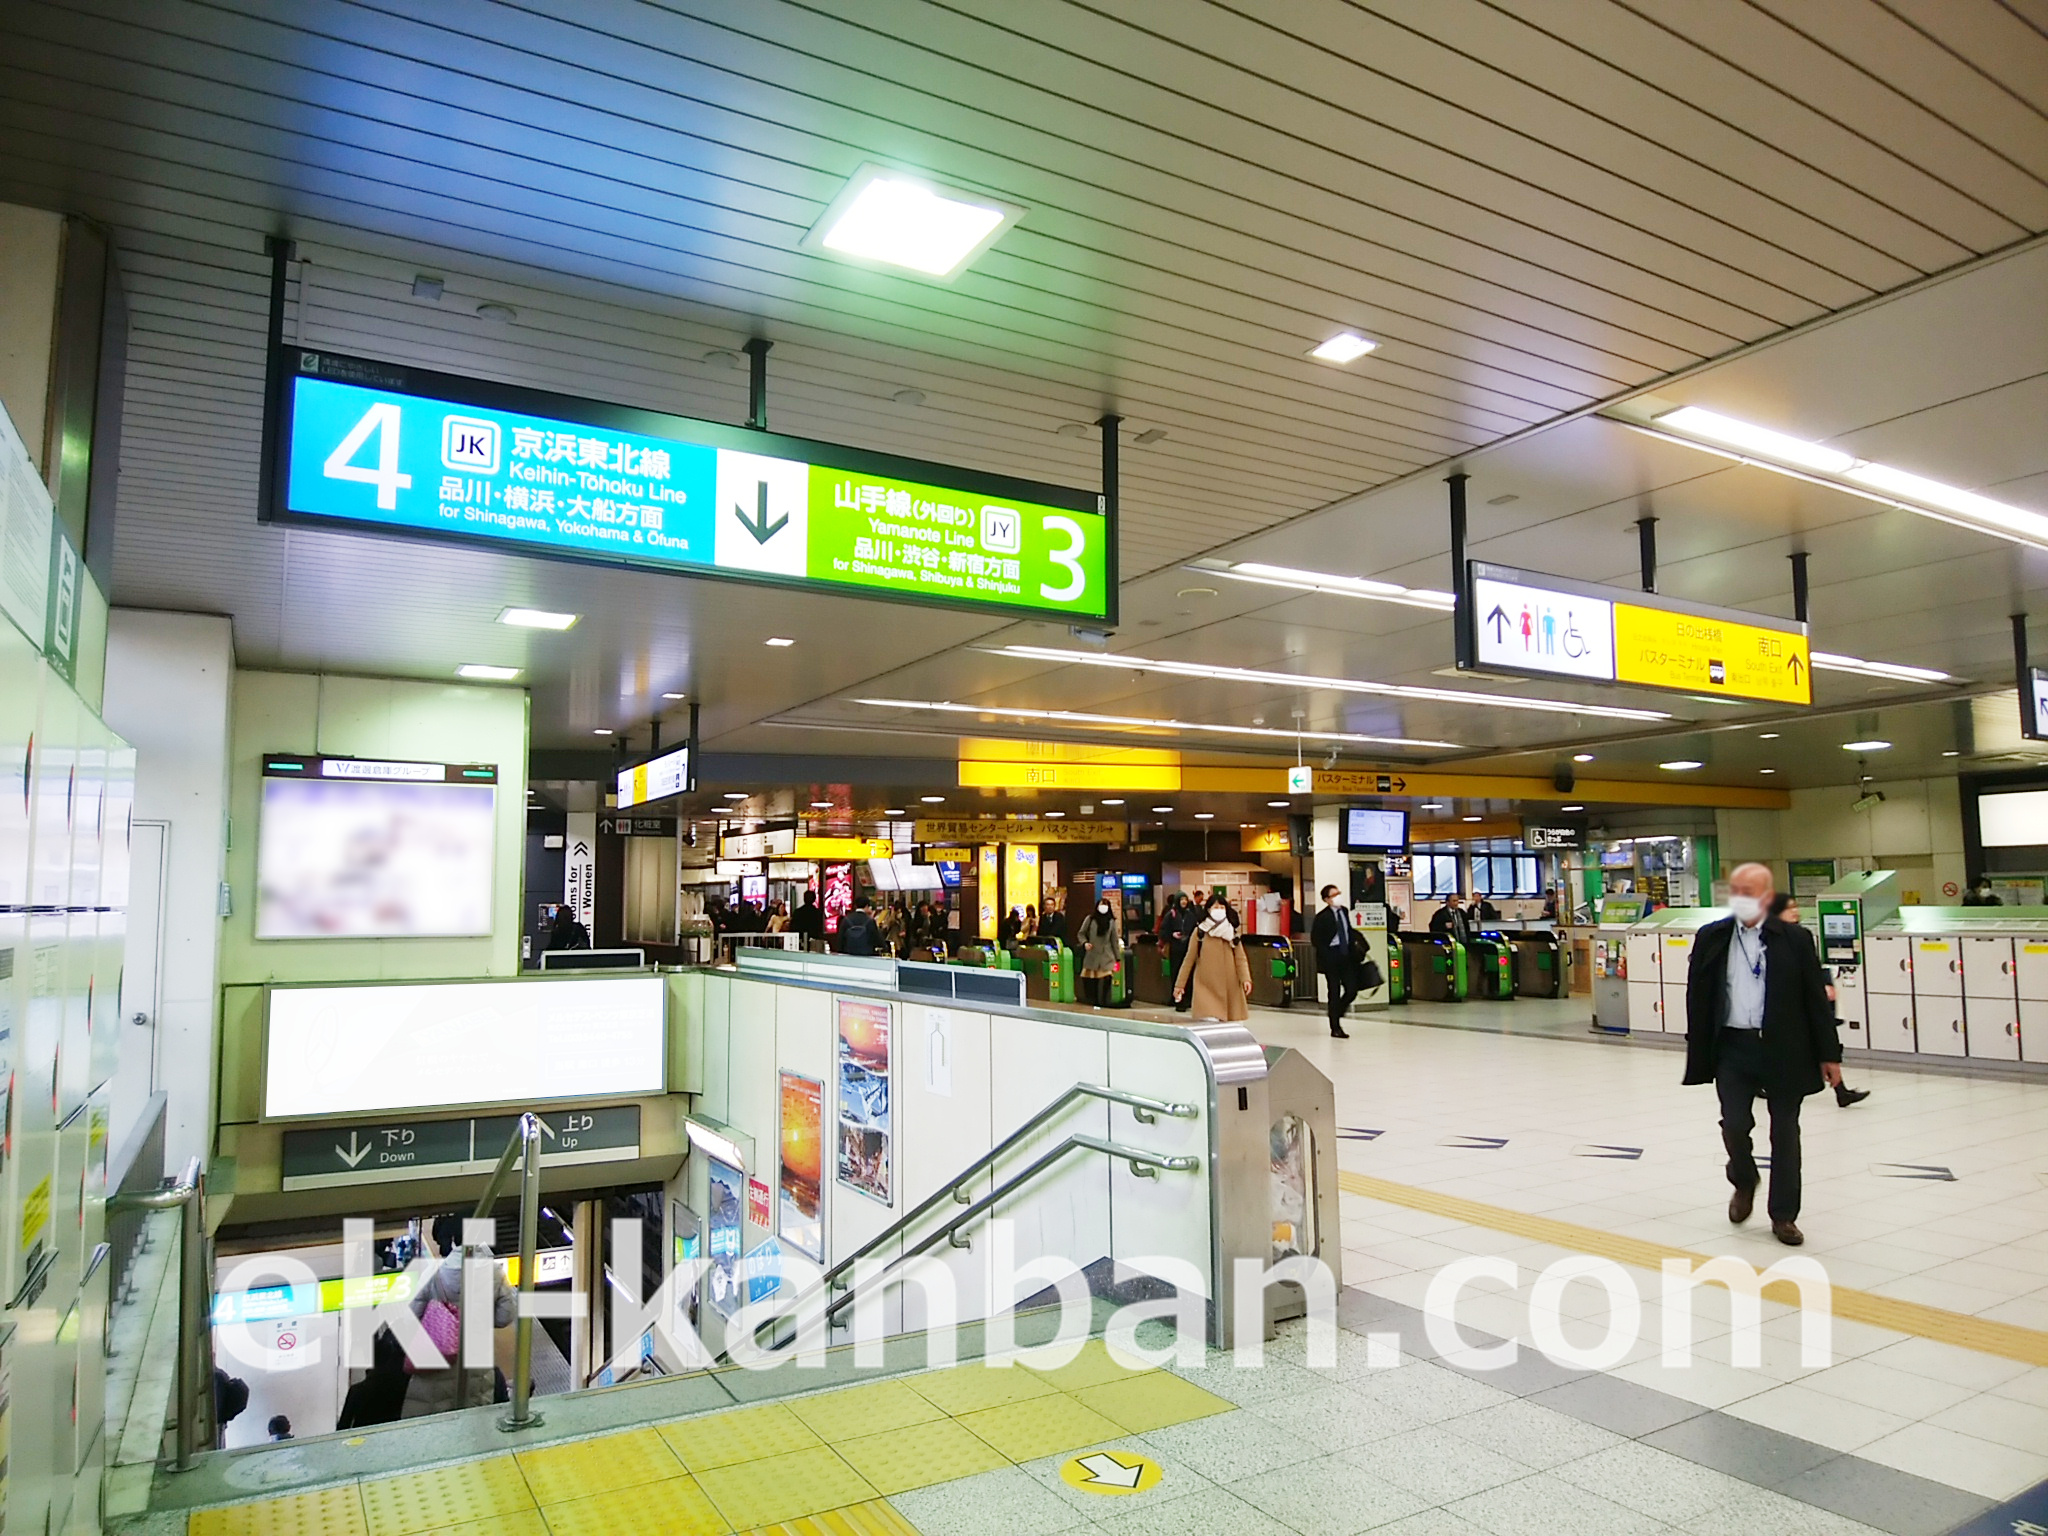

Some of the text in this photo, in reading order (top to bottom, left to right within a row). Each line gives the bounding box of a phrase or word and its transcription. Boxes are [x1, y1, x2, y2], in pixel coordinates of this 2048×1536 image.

[323, 401, 413, 511] 4
[456, 434, 486, 457] JK
[510, 426, 672, 480] 京浜東北線
[509, 461, 688, 505] Keihin-Tōhoku Line
[438, 475, 664, 530] 品川・横浜・大船方面
[438, 503, 460, 520] for
[463, 505, 552, 533] Shinagawa,
[555, 518, 630, 543] Yokohama
[633, 531, 644, 544] &
[868, 516, 975, 549] Yamanote Line
[989, 520, 1011, 539] JY
[854, 536, 1021, 581] 品川・渋谷・新宿方面
[1039, 515, 1087, 602] 3
[832, 557, 1021, 595] for Shinagawa, Shibuya & Shinjuku
[1757, 636, 1783, 659] 南口
[1639, 648, 1707, 672] バスターミナル
[1745, 658, 1784, 675] South Exit
[1025, 767, 1057, 785] 南口
[1317, 773, 1375, 786] バスターミナル
[634, 820, 661, 830] 化粧室
[1041, 823, 1109, 835] バスターミナル
[569, 866, 578, 884] for
[583, 864, 593, 909] Women
[561, 1115, 594, 1133] 上り
[381, 1128, 416, 1147] 下り
[561, 1137, 579, 1149] Up
[379, 1151, 415, 1163] Down
[394, 1275, 412, 1299] 3
[213, 1295, 237, 1322] 4
